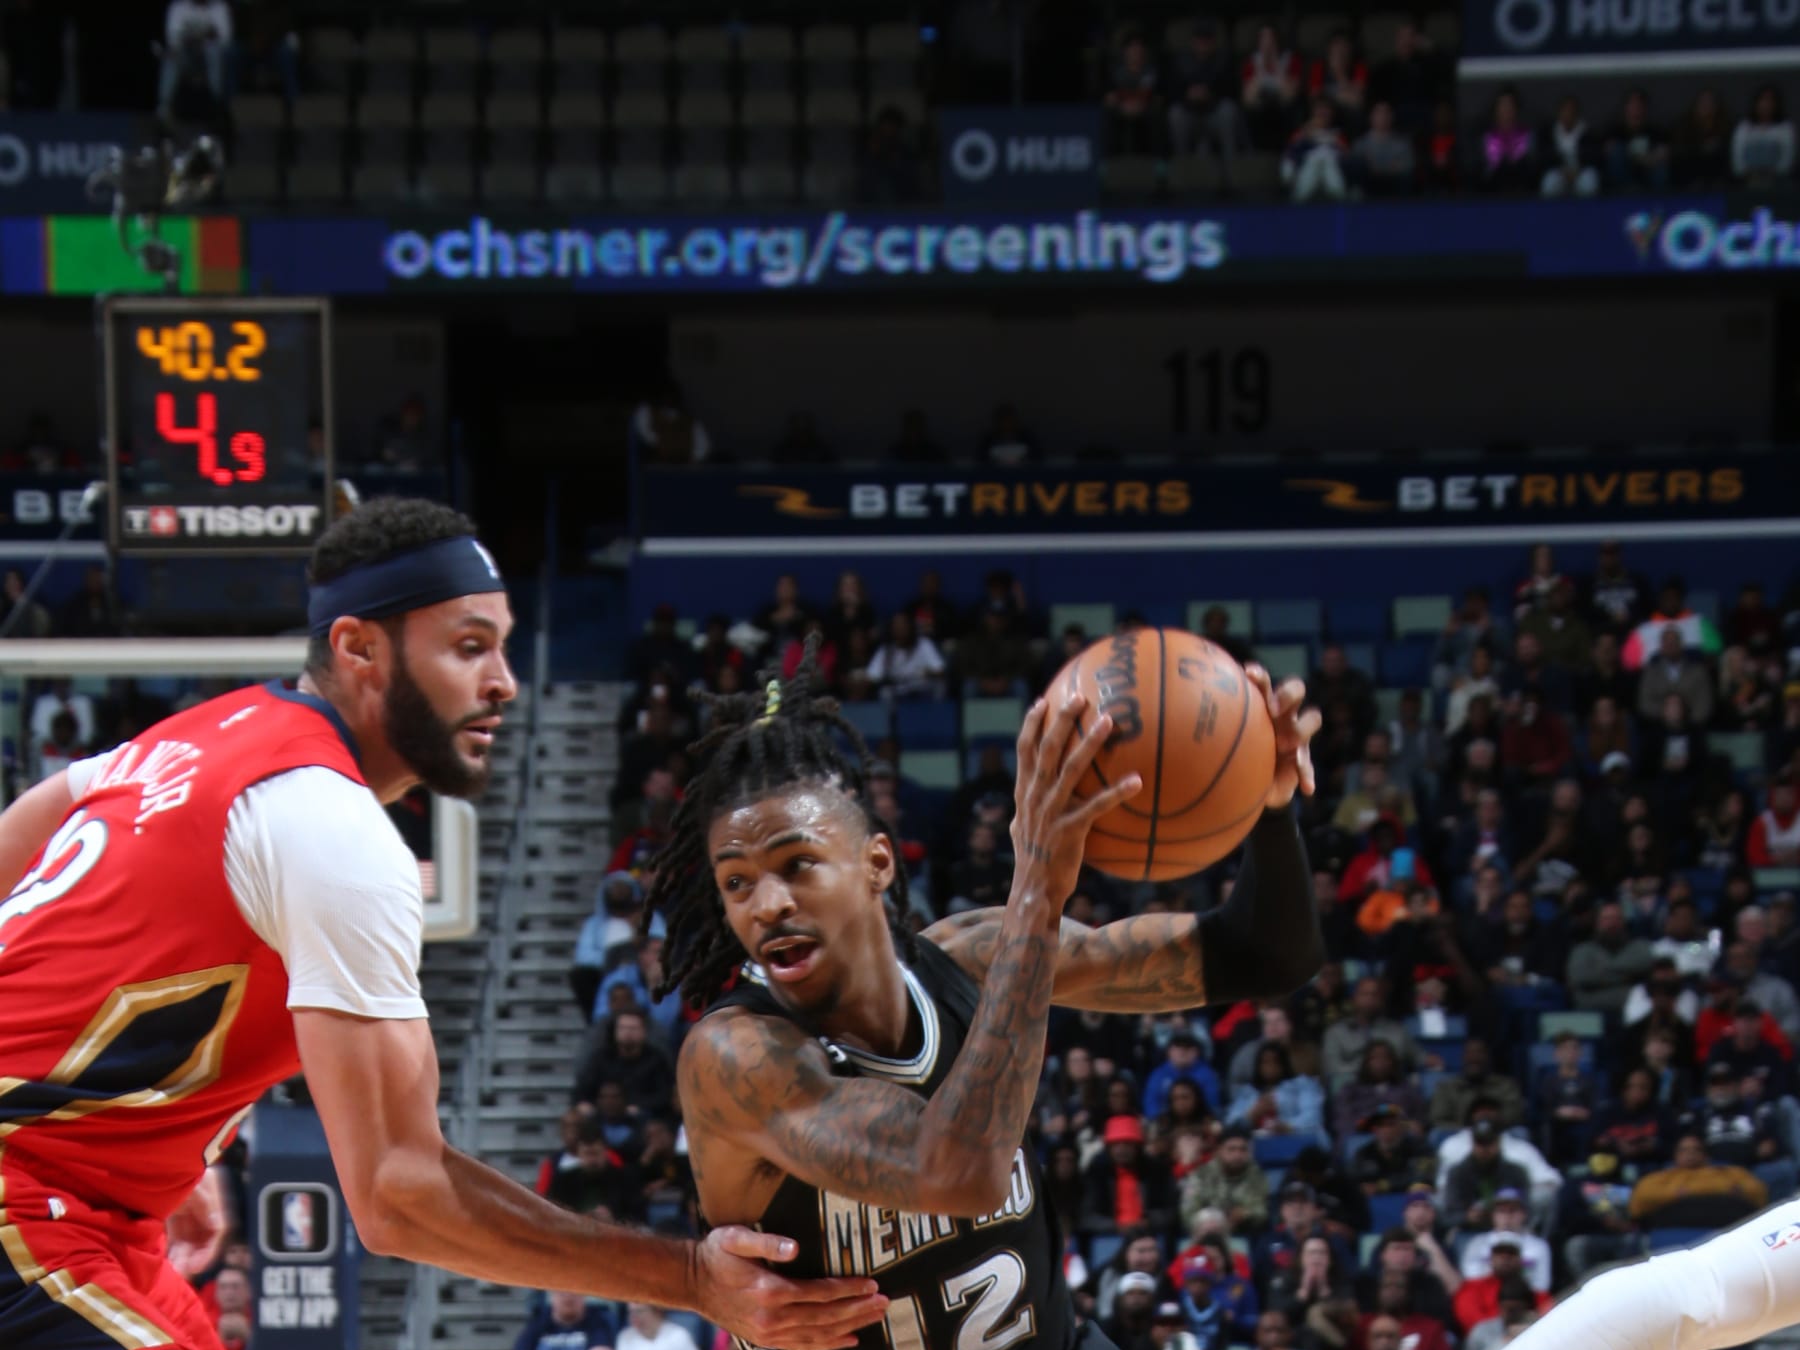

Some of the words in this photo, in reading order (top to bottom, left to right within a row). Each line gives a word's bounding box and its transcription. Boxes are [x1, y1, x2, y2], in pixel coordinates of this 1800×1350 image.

[1566, 0, 1682, 38] HUB
[1005, 135, 1093, 175] HUB
[383, 207, 1229, 285] ochsner.org/screenings
[1659, 205, 1800, 271] Och
[135, 319, 268, 382] 40.2
[1163, 345, 1272, 435] 119
[176, 504, 321, 537] TISSOT
